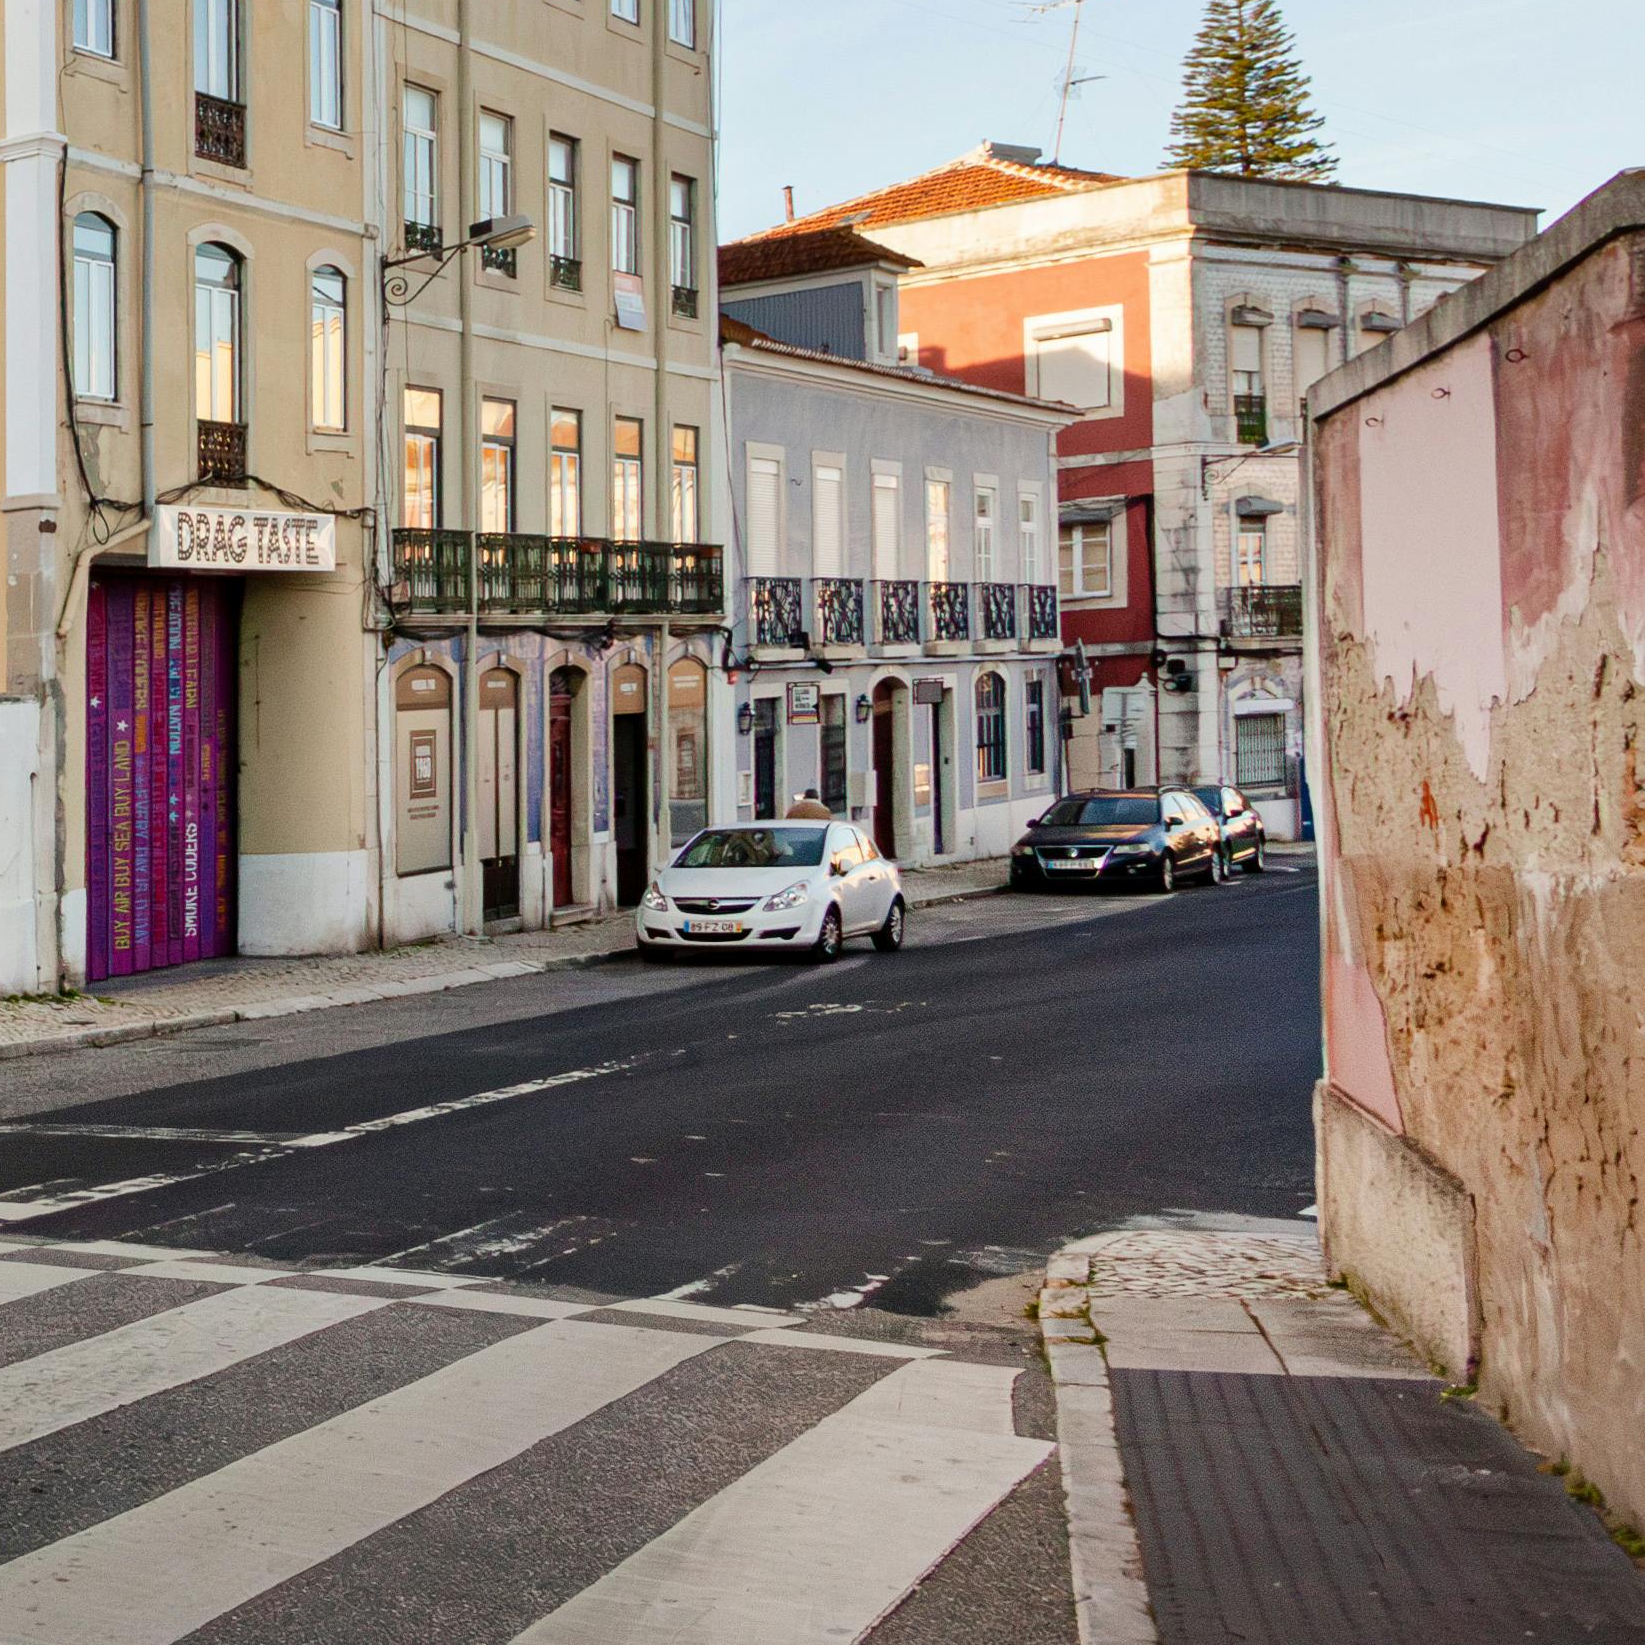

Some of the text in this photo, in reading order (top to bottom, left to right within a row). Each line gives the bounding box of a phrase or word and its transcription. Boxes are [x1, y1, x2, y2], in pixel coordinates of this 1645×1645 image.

[177, 511, 320, 565] DRAG TASTE
[113, 740, 131, 950] BUY AIR BUY SEA BUY LAND
